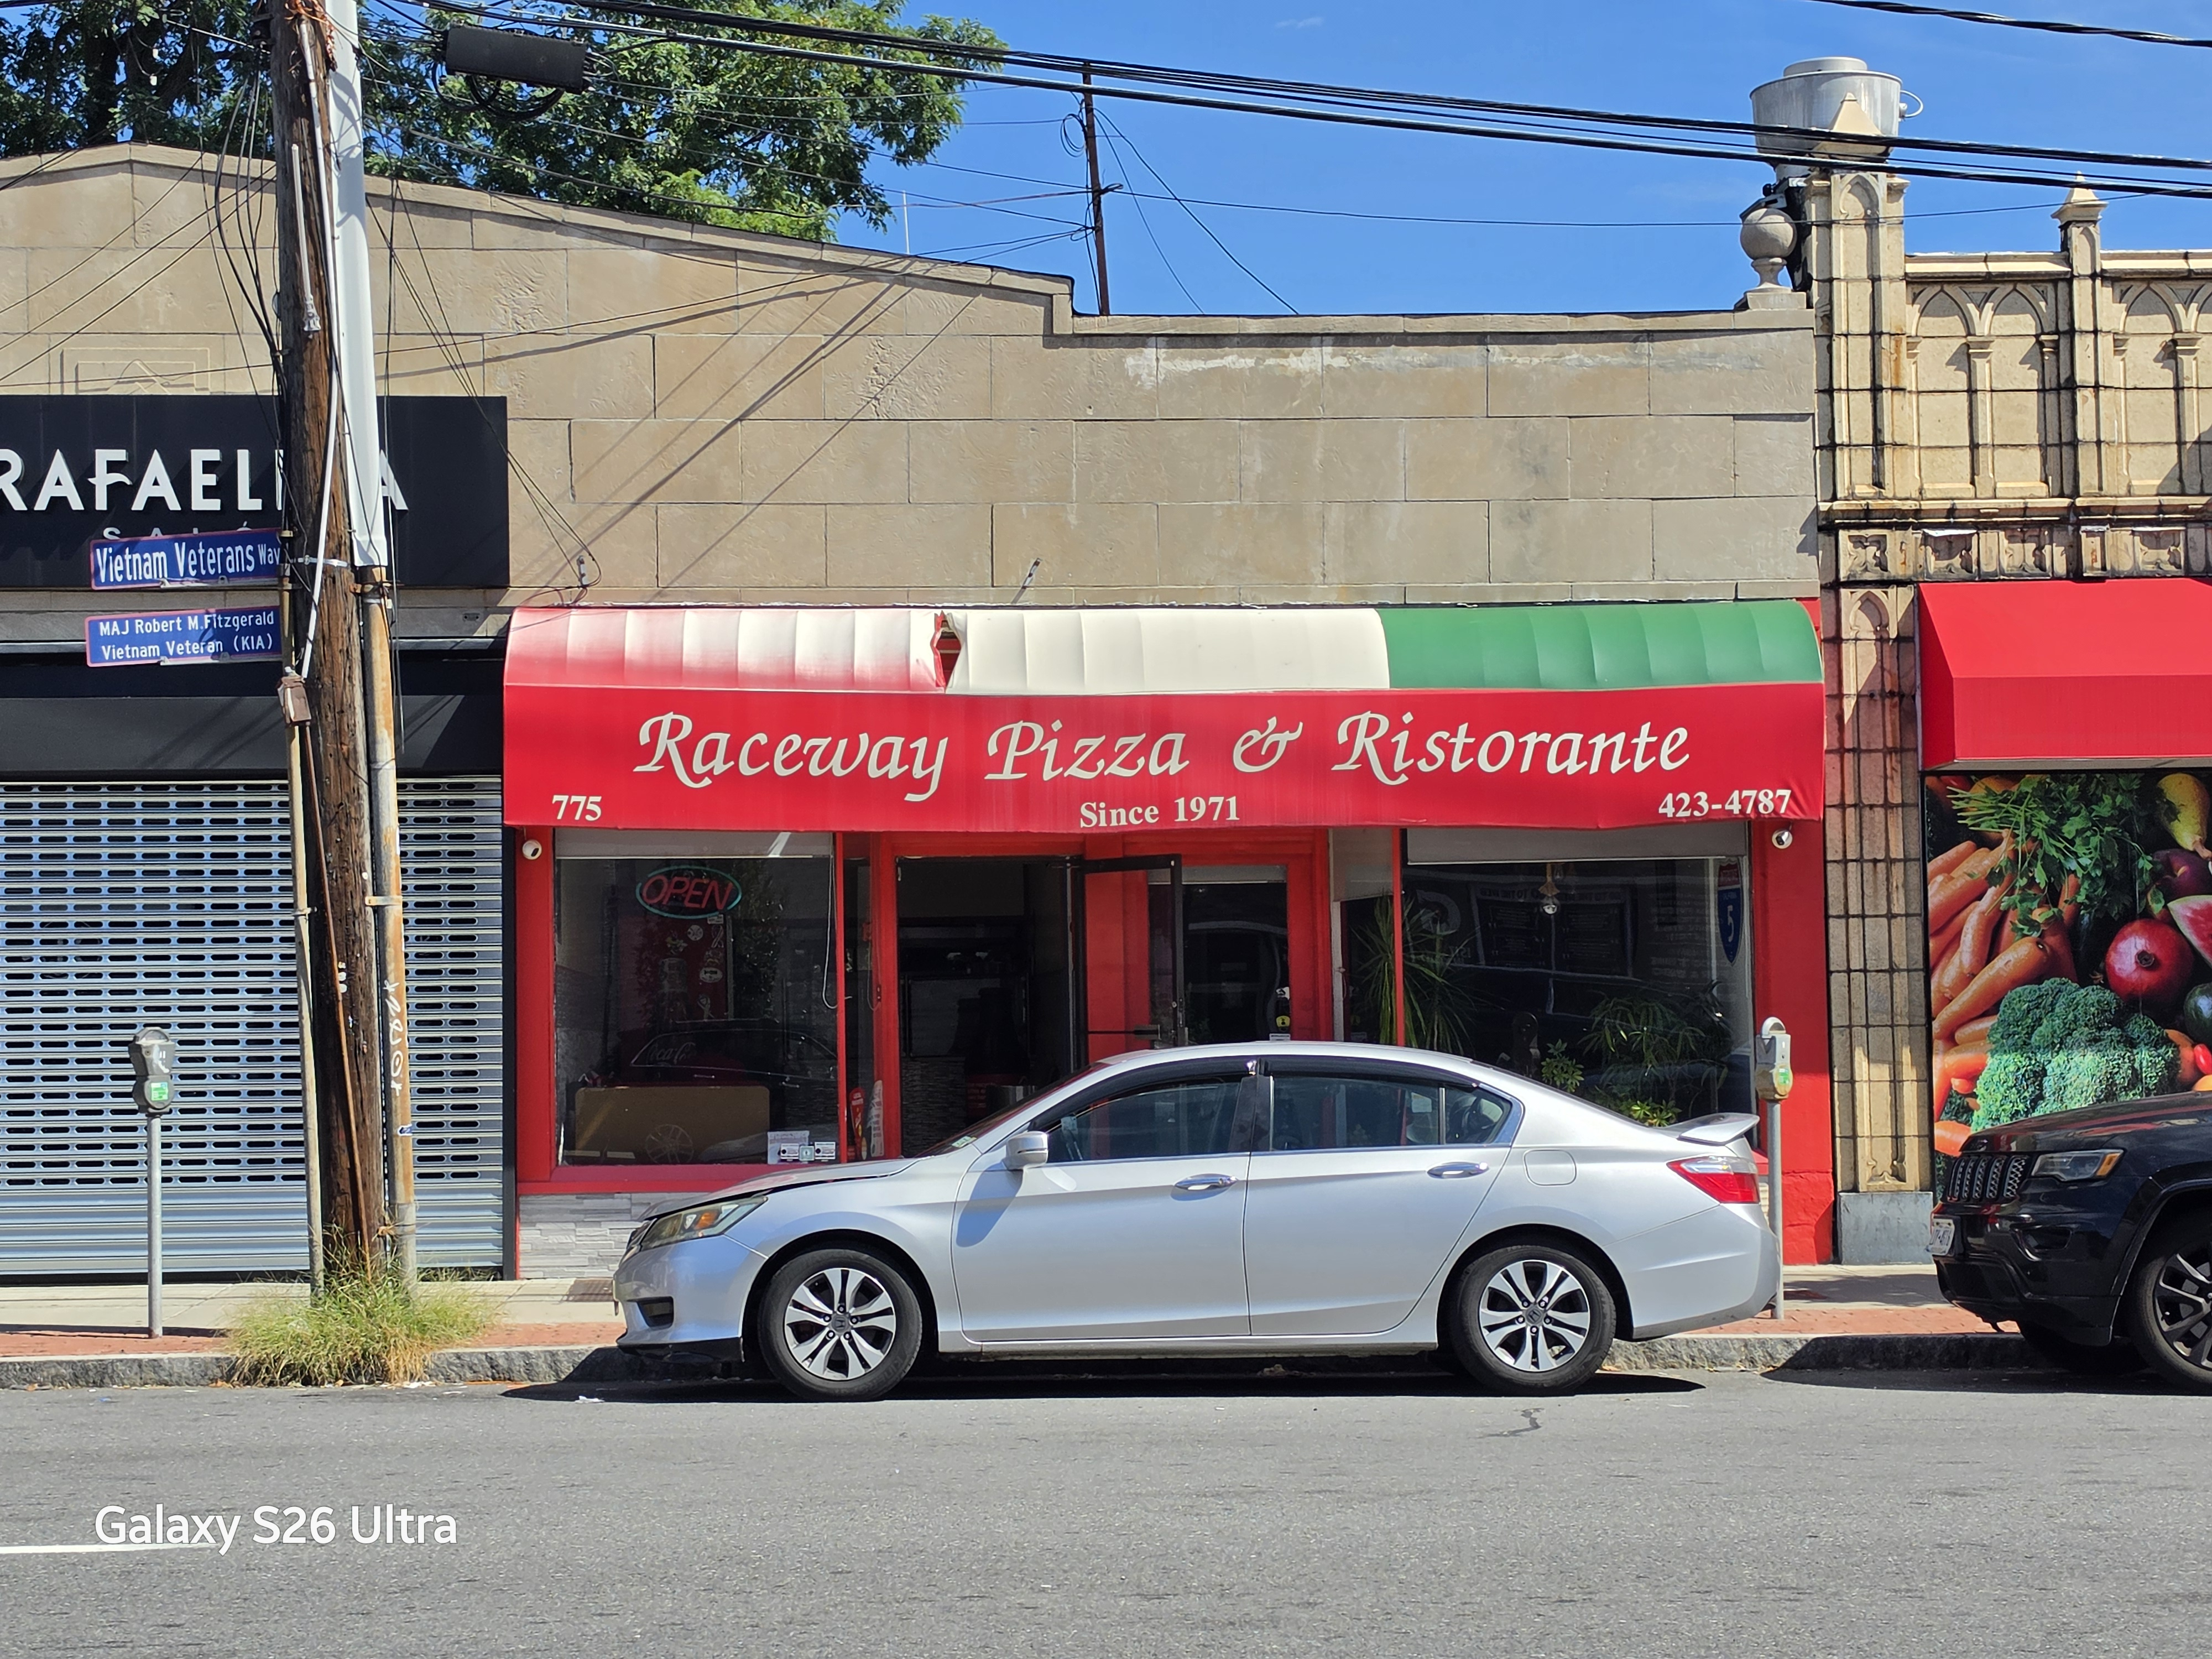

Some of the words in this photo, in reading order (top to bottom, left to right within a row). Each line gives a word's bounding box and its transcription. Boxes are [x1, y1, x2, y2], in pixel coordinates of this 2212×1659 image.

[96, 547, 168, 583] Vietnam
[174, 541, 255, 577] Veterans
[258, 544, 280, 566] Way
[100, 620, 129, 636] MAJ
[135, 617, 182, 634] Robert
[102, 645, 160, 660] Vietnam
[166, 640, 223, 656] Veteran
[233, 633, 273, 653] (KIA)
[634, 711, 948, 802] Raceway
[984, 719, 1190, 781] Pizza
[1233, 716, 1303, 773] &
[1331, 711, 1689, 785] Ristorante
[552, 795, 602, 821] 775
[1079, 802, 1159, 828] Since
[1173, 796, 1240, 822] 1971
[1658, 789, 1792, 818] 423-4787
[642, 875, 733, 910] OPEN
